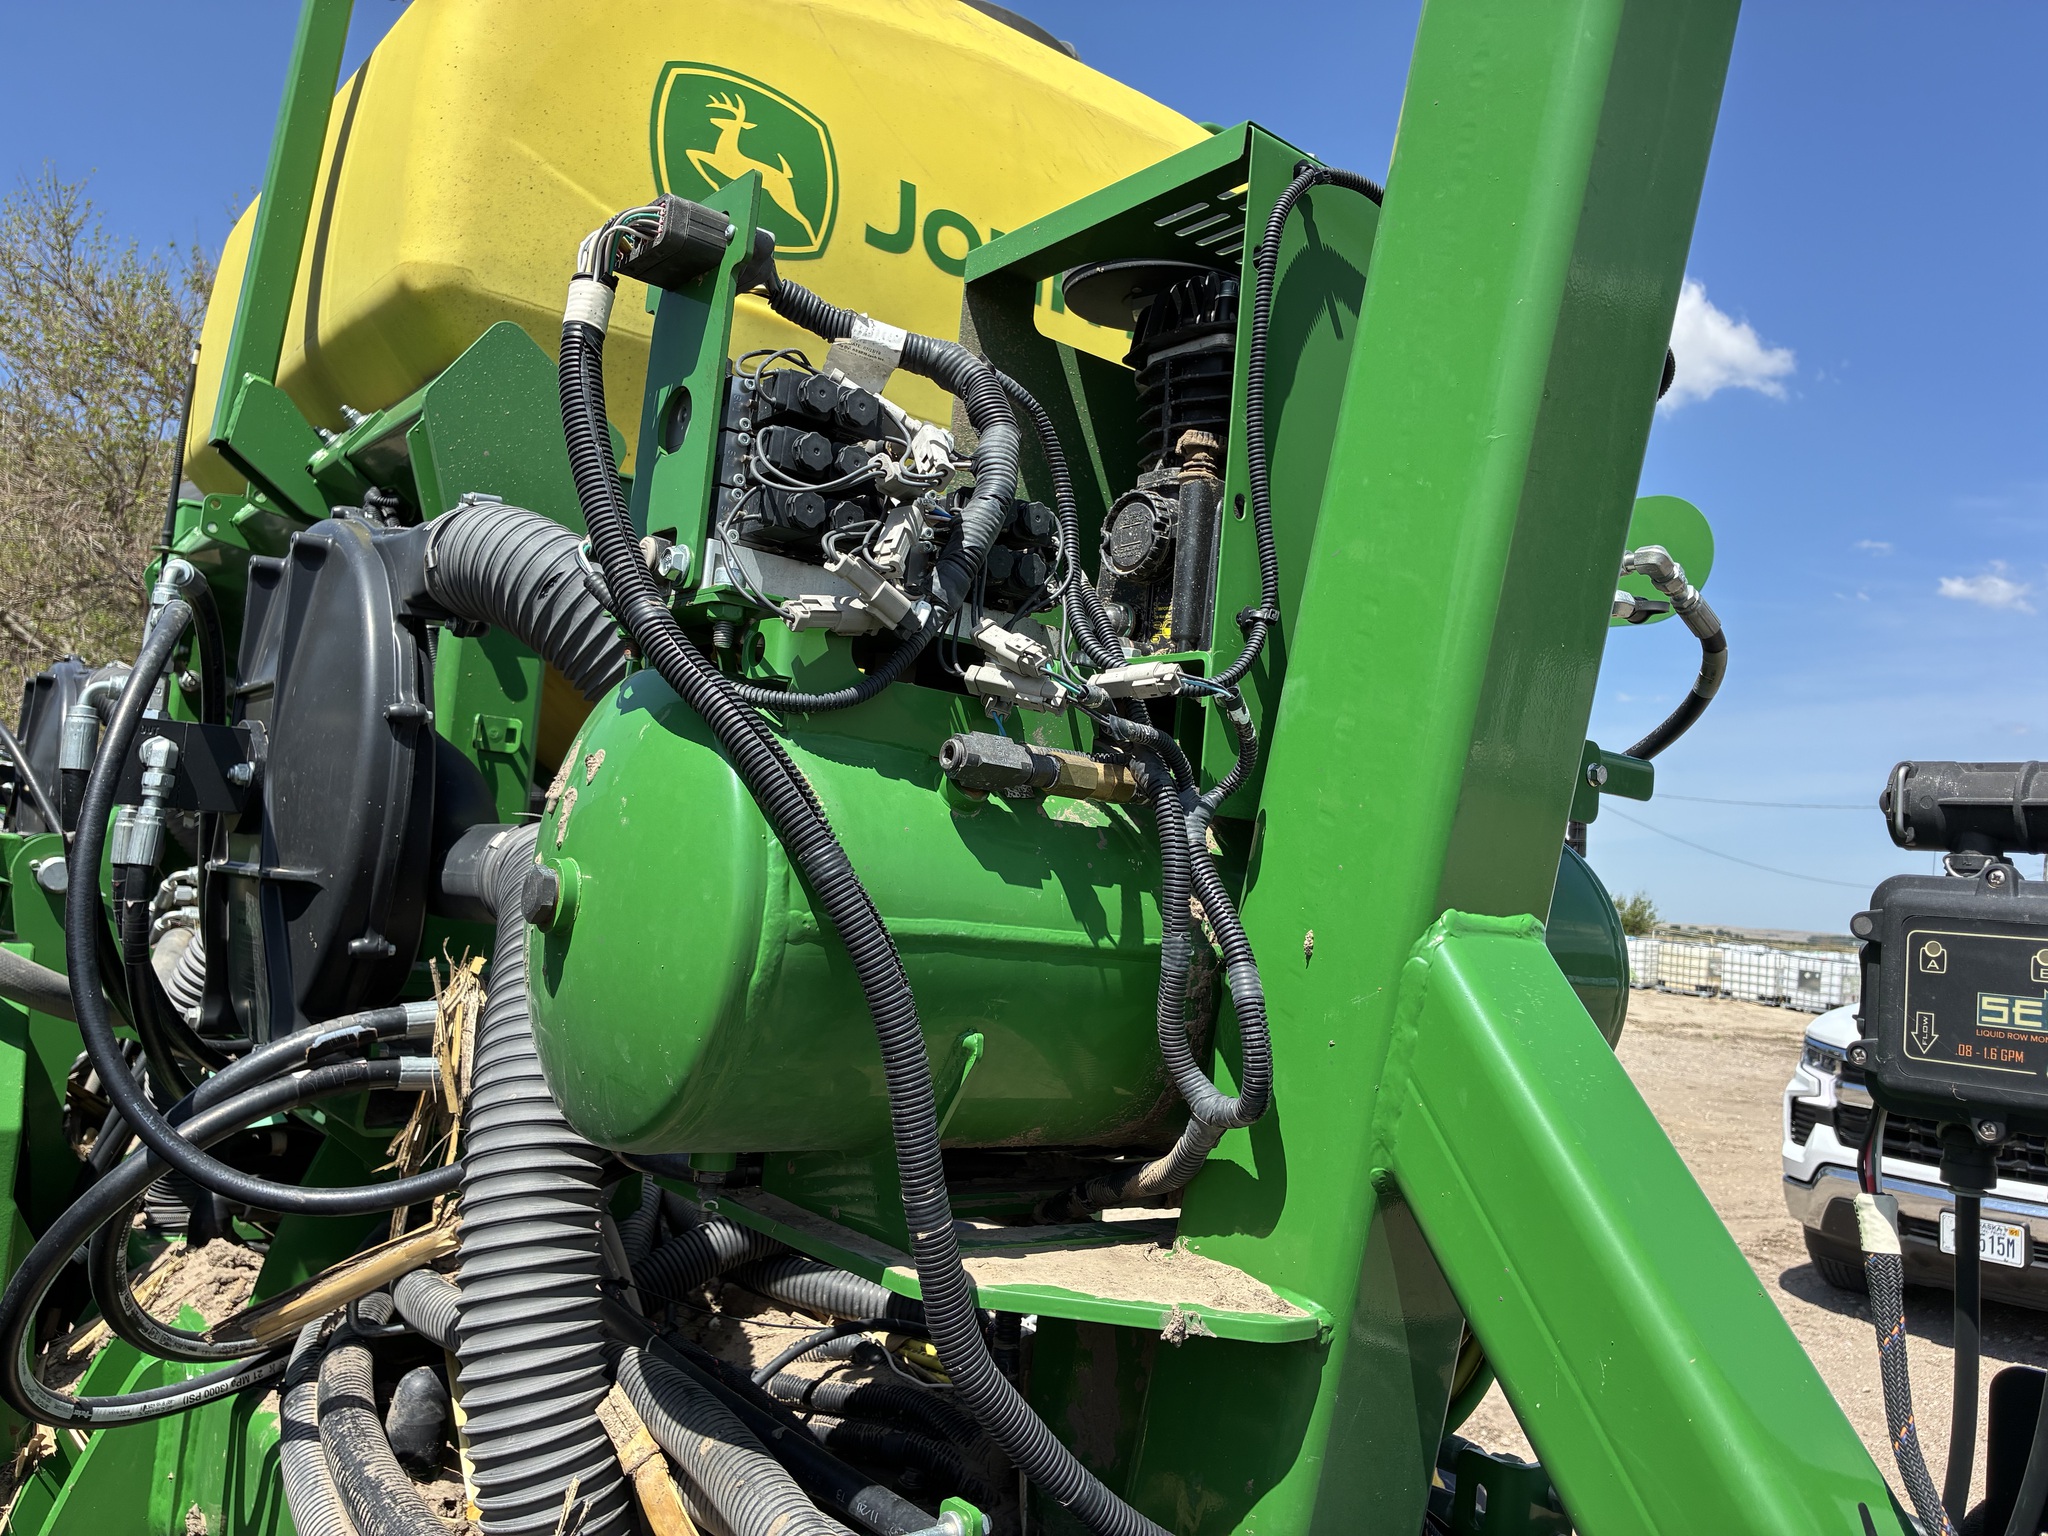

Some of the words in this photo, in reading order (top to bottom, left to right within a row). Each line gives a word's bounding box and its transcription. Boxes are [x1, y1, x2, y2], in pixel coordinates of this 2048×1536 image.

[1927, 959, 1939, 970] A
[1976, 1029, 2006, 1039] LIQUID
[2007, 1032, 2029, 1042] ROW
[1984, 1047, 1997, 1061] 1.6
[2001, 1048, 2024, 1063] GPM
[231, 1374, 251, 1389] MPa
[253, 1369, 264, 1379] 21
[182, 1391, 202, 1406] PSI)
[203, 1383, 229, 1399] (3000
